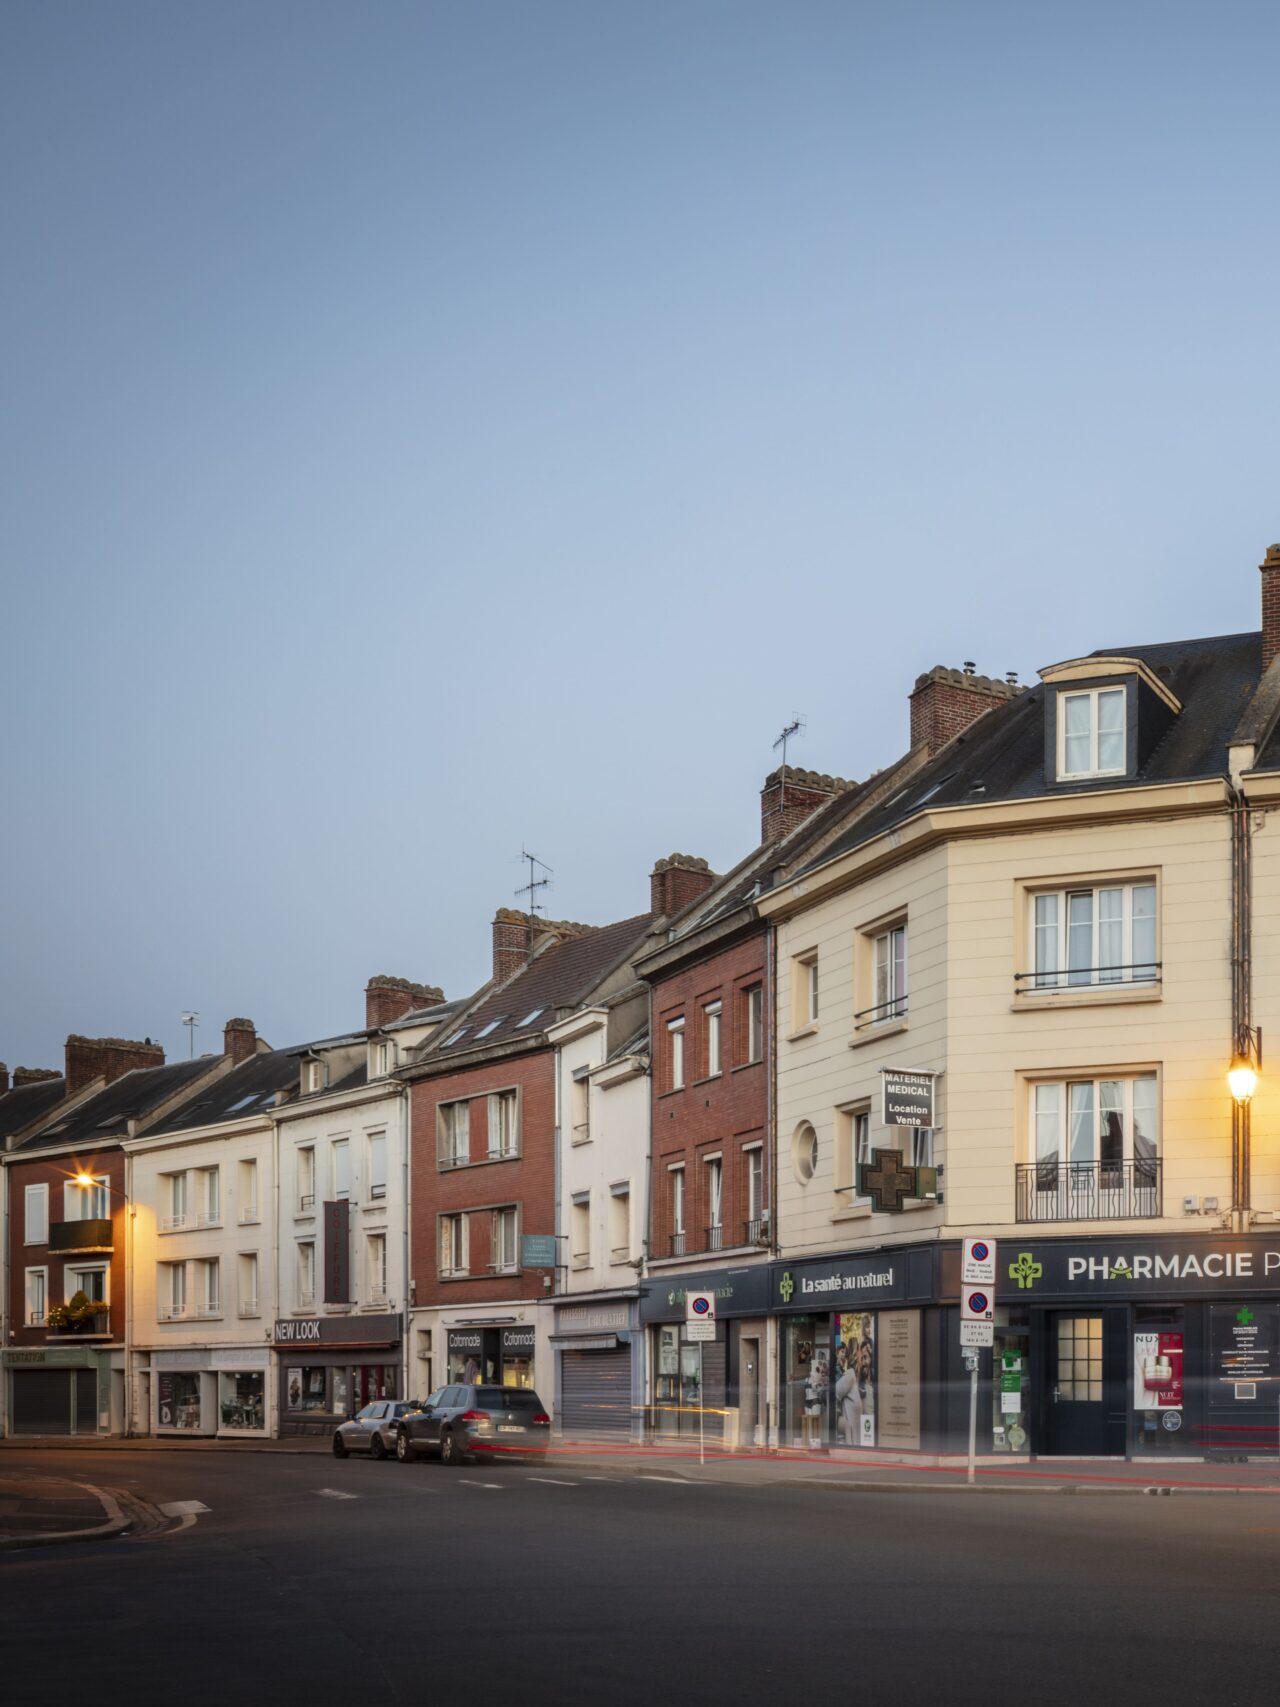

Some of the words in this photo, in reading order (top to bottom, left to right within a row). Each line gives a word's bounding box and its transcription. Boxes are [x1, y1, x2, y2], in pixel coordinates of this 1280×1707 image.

[885, 1073, 931, 1085] MATERIEL
[888, 1085, 929, 1096] MEDICAL
[889, 1104, 928, 1114] Location
[896, 1116, 921, 1125] Vente
[1068, 1252, 1254, 1281] PHARMACIE
[801, 1278, 814, 1293] La
[814, 1273, 842, 1292] santé
[842, 1276, 855, 1290] au
[857, 1268, 893, 1288] naturel
[275, 1323, 295, 1340] NEW
[296, 1321, 320, 1339] LOOK
[450, 1334, 480, 1348] Cotonnade
[503, 1332, 535, 1346] Cotonnade
